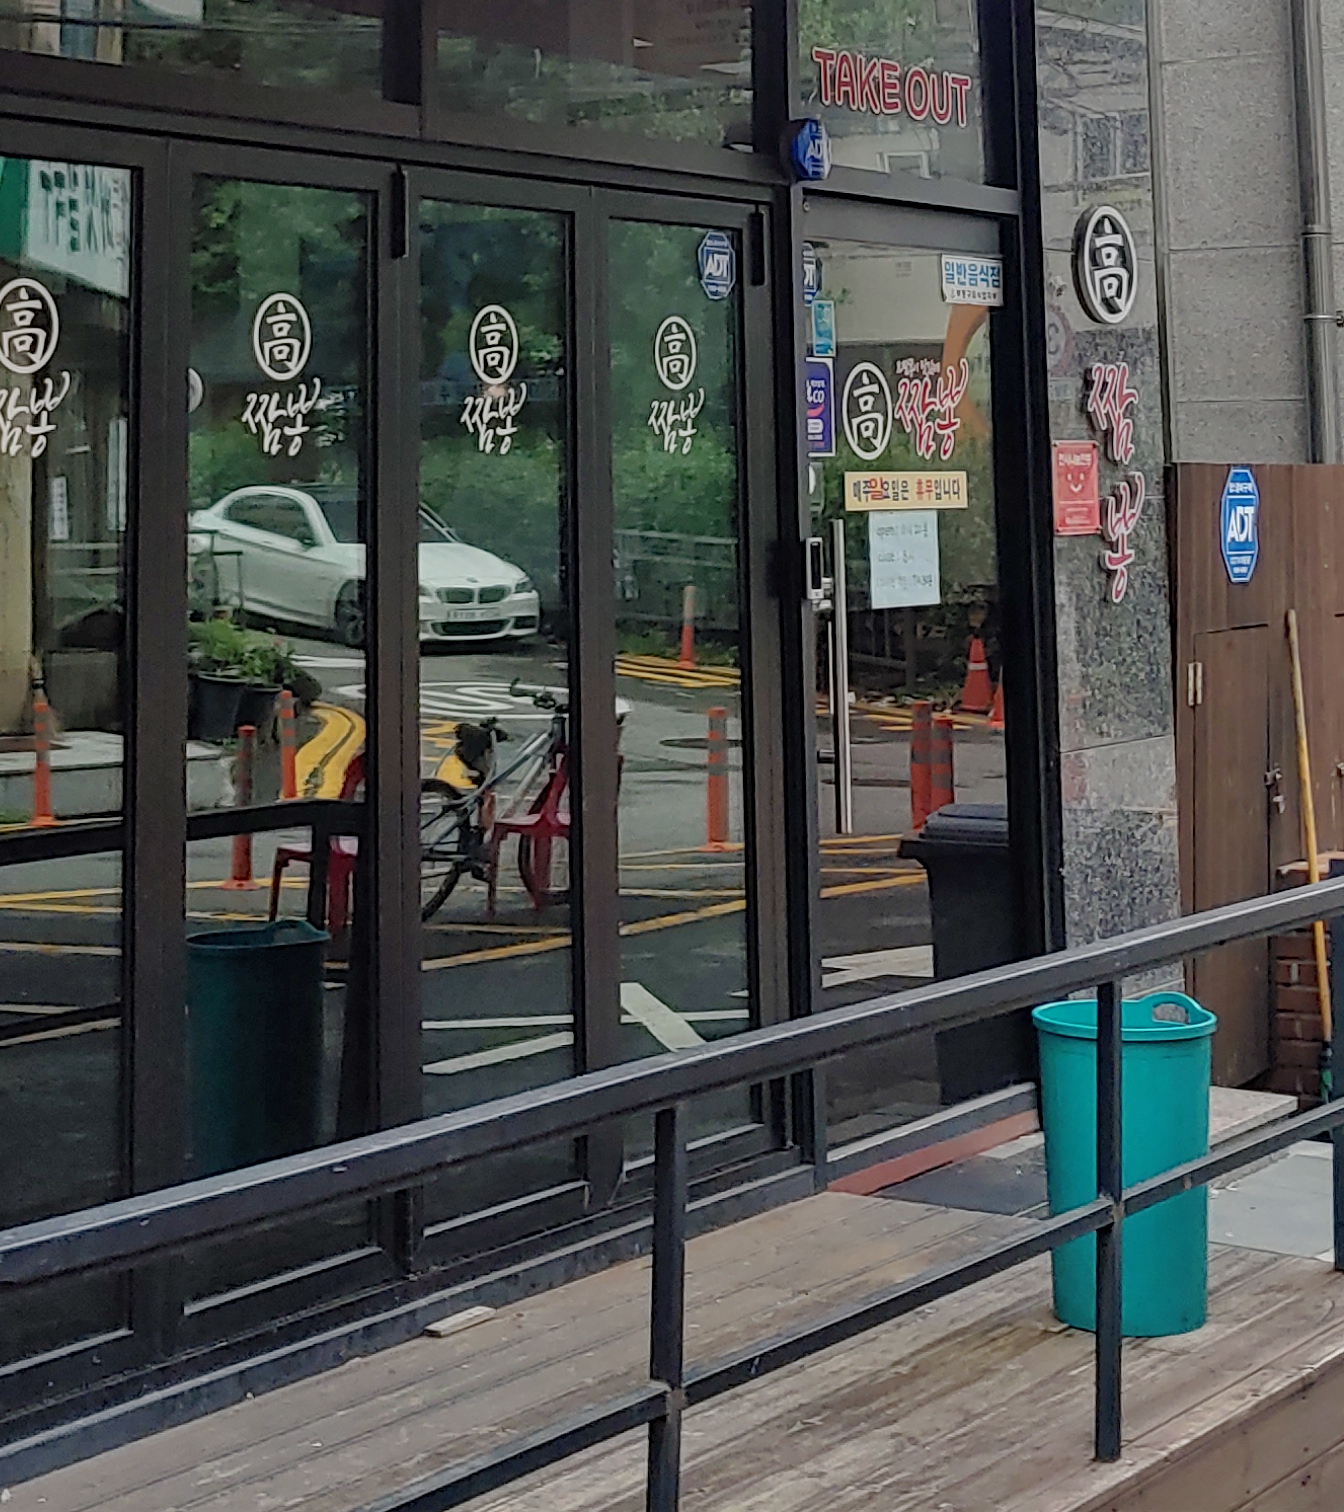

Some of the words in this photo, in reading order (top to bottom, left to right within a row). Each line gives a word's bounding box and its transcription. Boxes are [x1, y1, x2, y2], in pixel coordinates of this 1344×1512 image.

[812, 46, 901, 115] TAKE
[904, 65, 972, 128] OUT
[704, 253, 730, 279] ADT
[944, 261, 1001, 289] 일반음식점
[1092, 218, 1130, 315] 高
[2, 287, 46, 365] 高
[263, 301, 301, 373] 高
[479, 312, 511, 380] 高
[662, 322, 689, 386] 高
[241, 377, 322, 457] 짬뽕
[460, 382, 528, 456] 짬뽕
[647, 387, 706, 455] 짬뽕
[851, 371, 885, 450] 高
[895, 357, 969, 461] 짬뽕
[1087, 362, 1145, 604] 짬뽕
[1227, 505, 1256, 544] ADT
